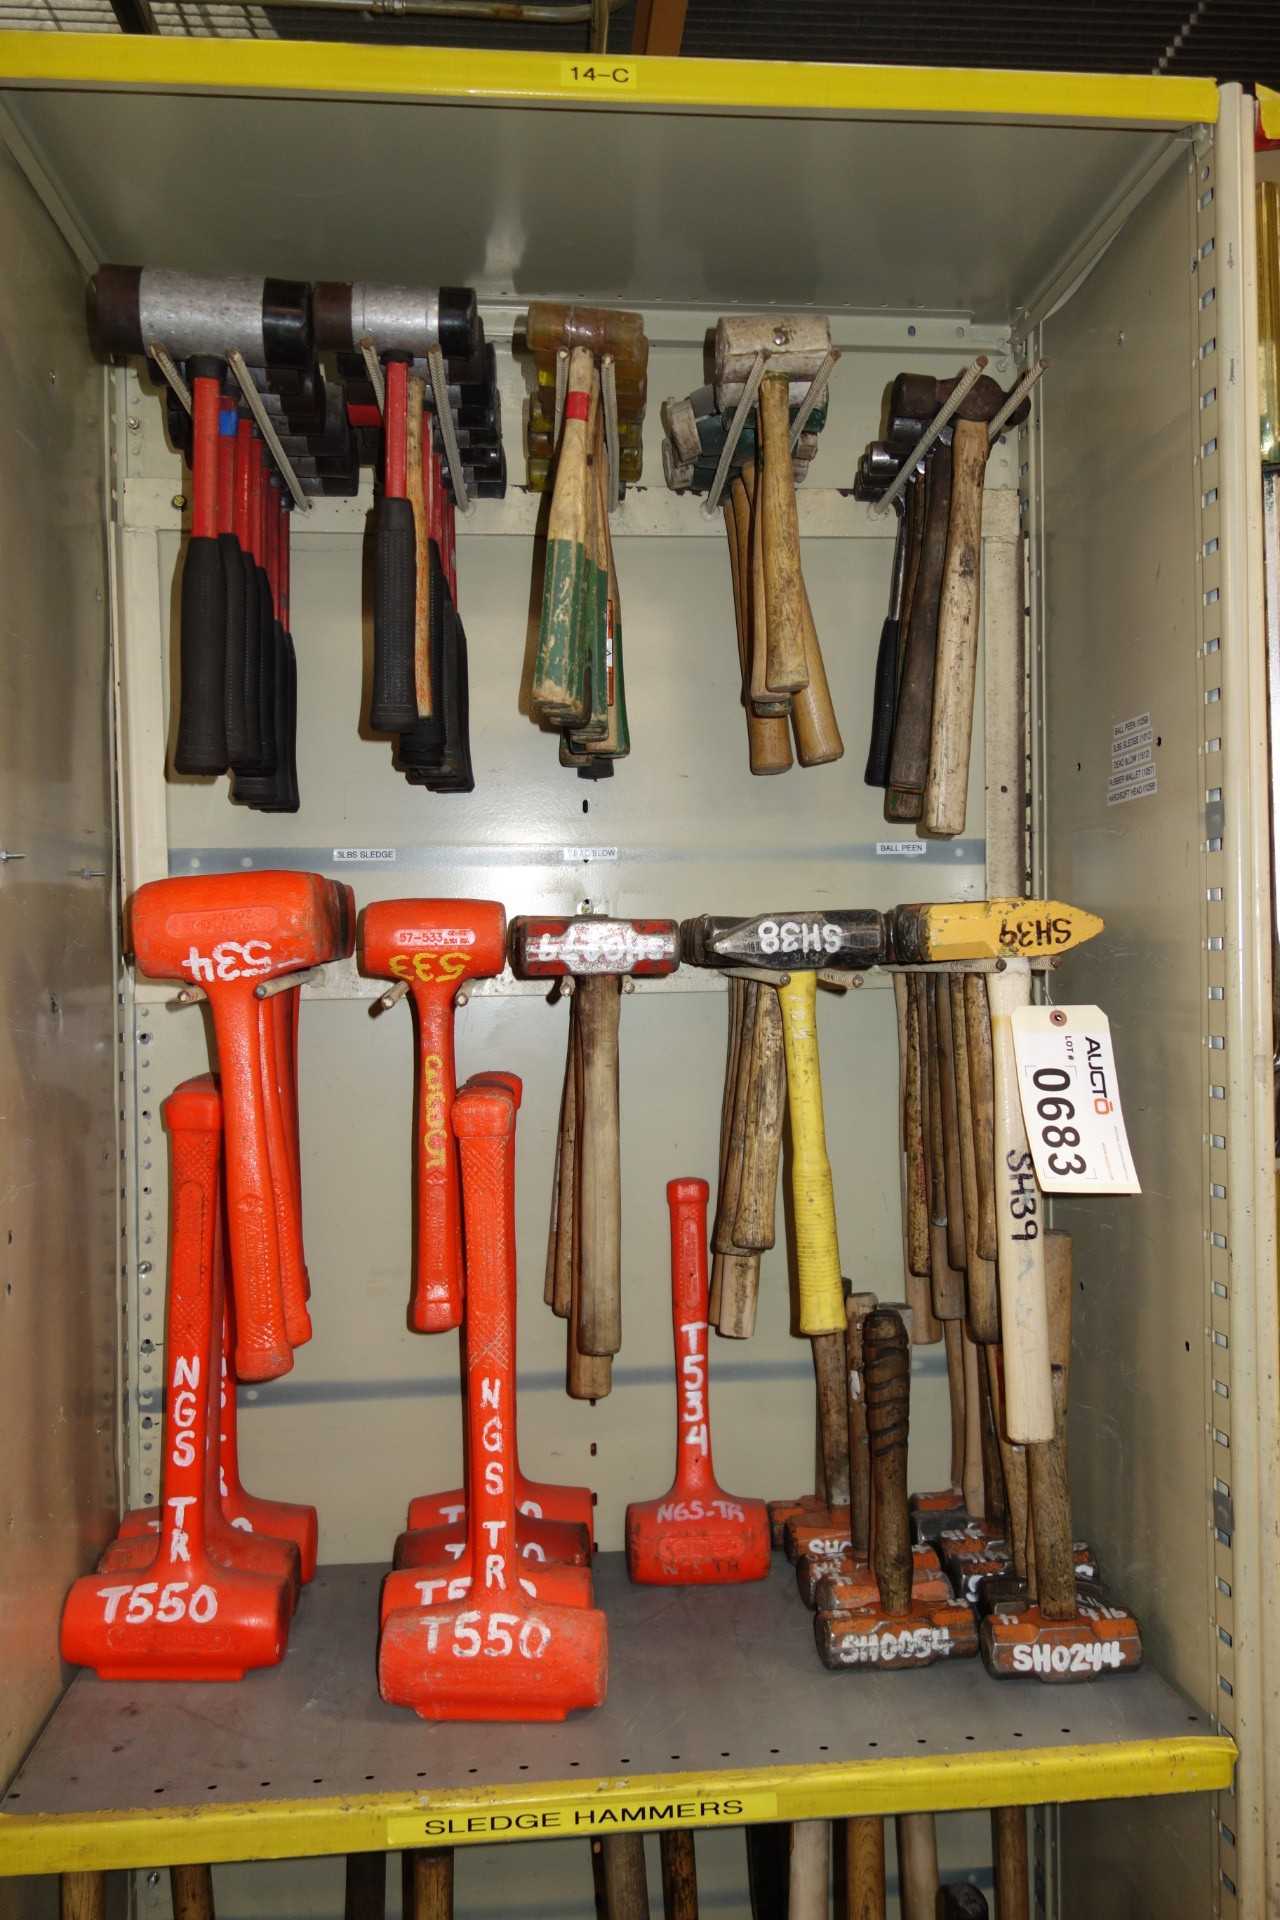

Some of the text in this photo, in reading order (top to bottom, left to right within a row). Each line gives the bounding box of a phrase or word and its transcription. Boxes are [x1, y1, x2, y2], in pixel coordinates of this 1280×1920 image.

[570, 66, 629, 83] 14-C
[360, 850, 394, 859] SLEDGE
[758, 921, 843, 954] SH38
[998, 918, 1072, 948] SH39
[388, 952, 472, 982] 533
[1064, 1035, 1074, 1054] LOT
[1032, 1067, 1087, 1176] 0683
[1006, 1149, 1039, 1241] SH39
[172, 1355, 200, 1467] NGS
[480, 1376, 505, 1496] NGS
[482, 1520, 507, 1590] TR
[96, 1582, 219, 1624] T550
[419, 1610, 551, 1659] T550
[424, 1799, 745, 1836] SLEDGE HAMMERS
